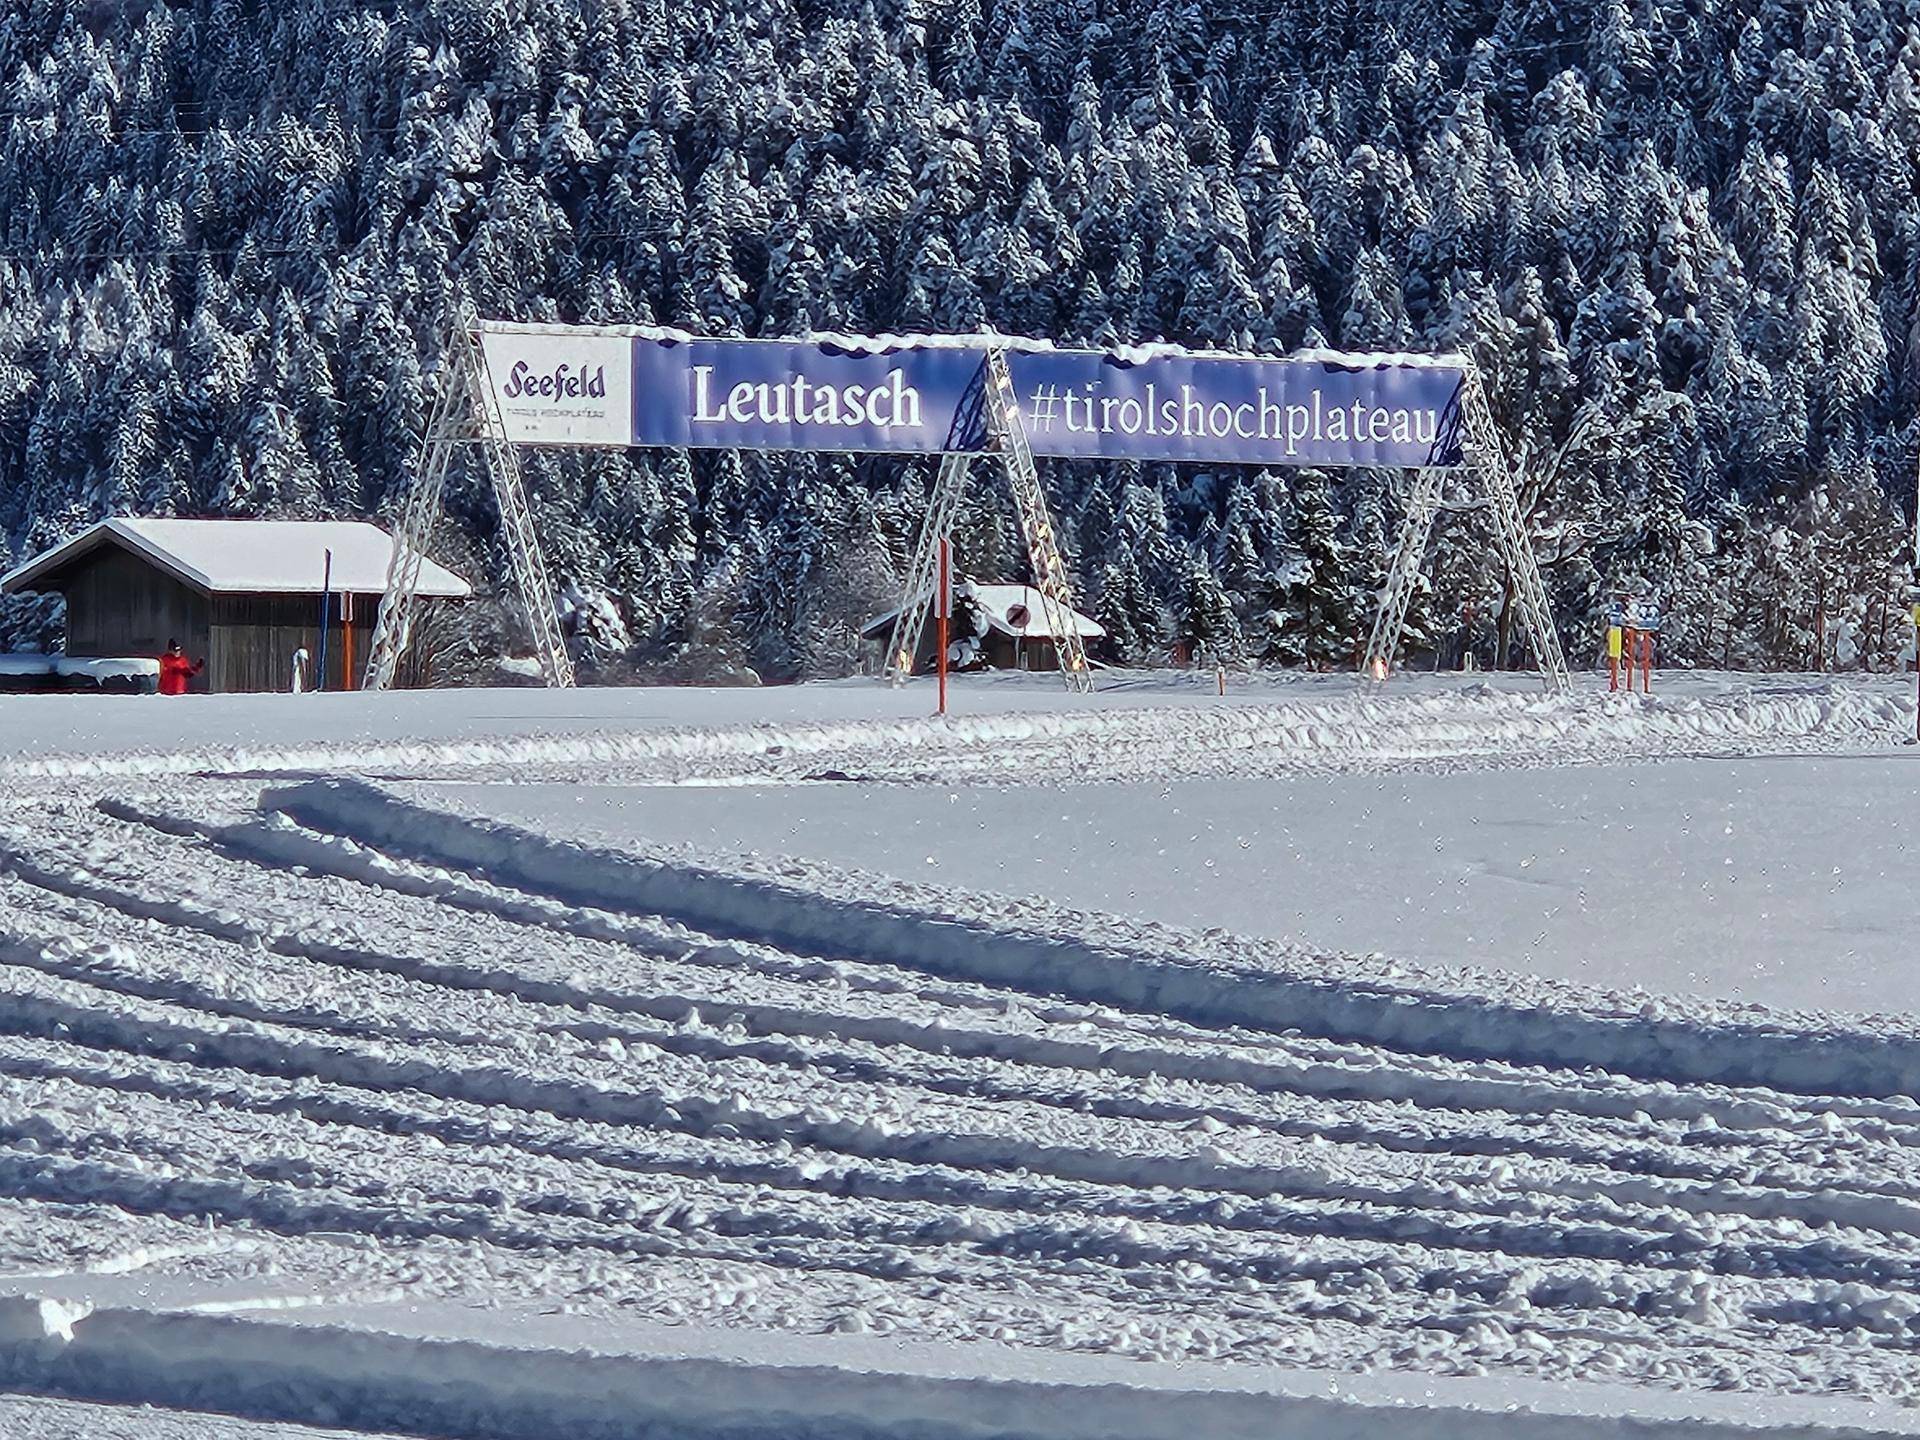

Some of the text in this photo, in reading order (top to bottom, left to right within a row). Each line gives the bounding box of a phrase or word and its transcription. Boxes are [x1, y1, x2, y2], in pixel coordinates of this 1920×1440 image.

[503, 360, 606, 402] Seefeld
[692, 365, 923, 428] Leutasch
[1028, 382, 1437, 456] #tirolshochplateau
